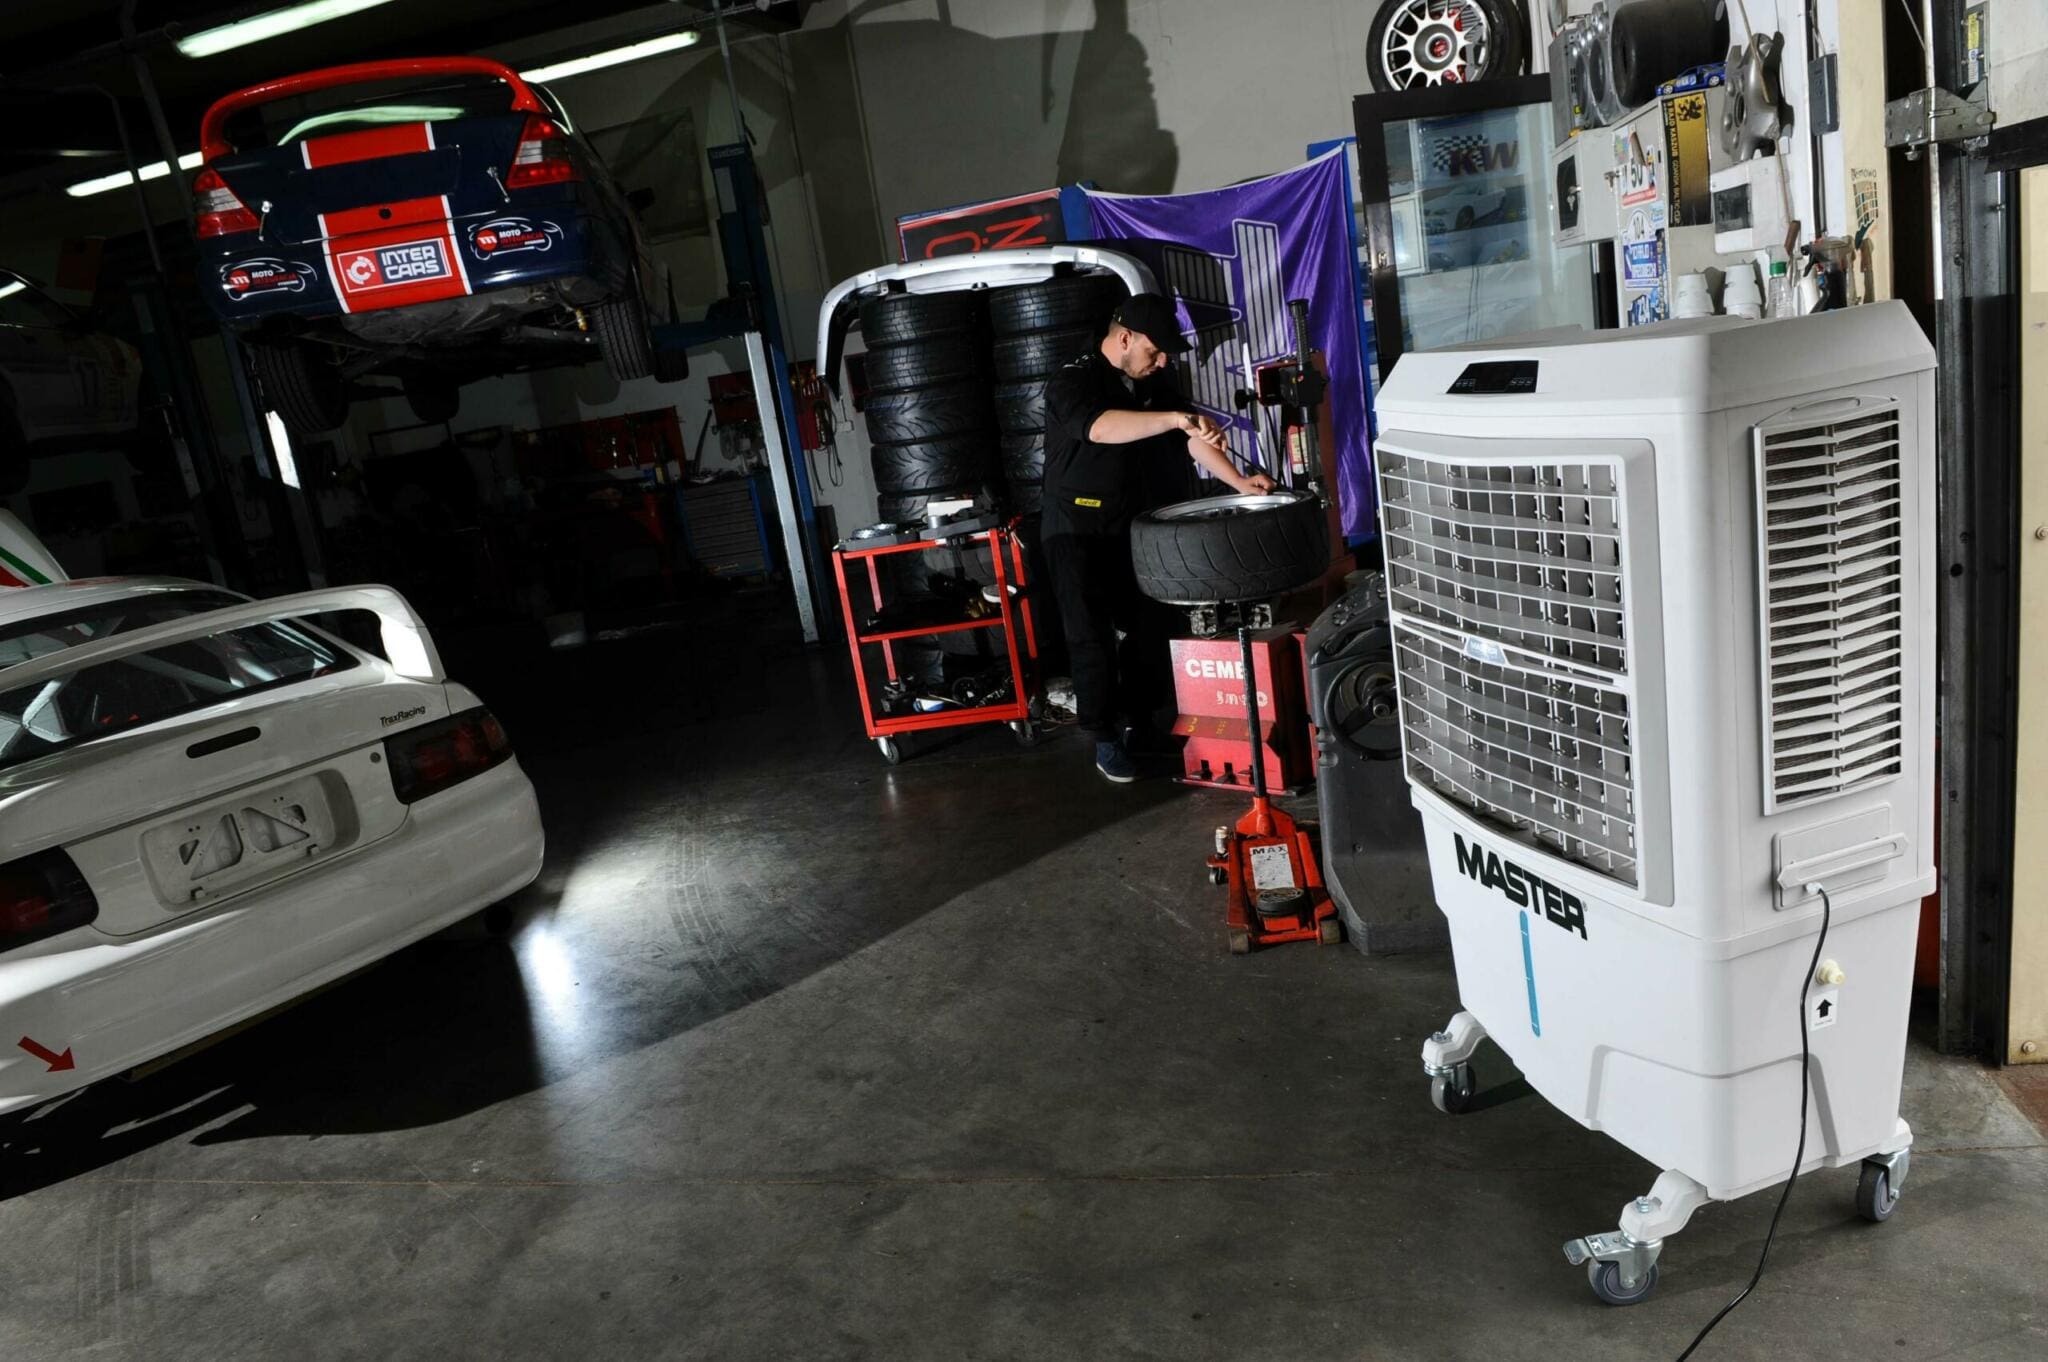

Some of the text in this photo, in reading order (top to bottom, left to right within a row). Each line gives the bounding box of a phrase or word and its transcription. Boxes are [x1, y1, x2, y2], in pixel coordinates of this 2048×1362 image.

[1450, 140, 1518, 177] KW
[498, 229, 522, 239] MOTO
[381, 245, 437, 266] INTER
[251, 270, 274, 279] MOTO
[385, 260, 440, 280] CARS
[380, 705, 426, 728] TraxRacing
[1453, 831, 1588, 941] MASTER
